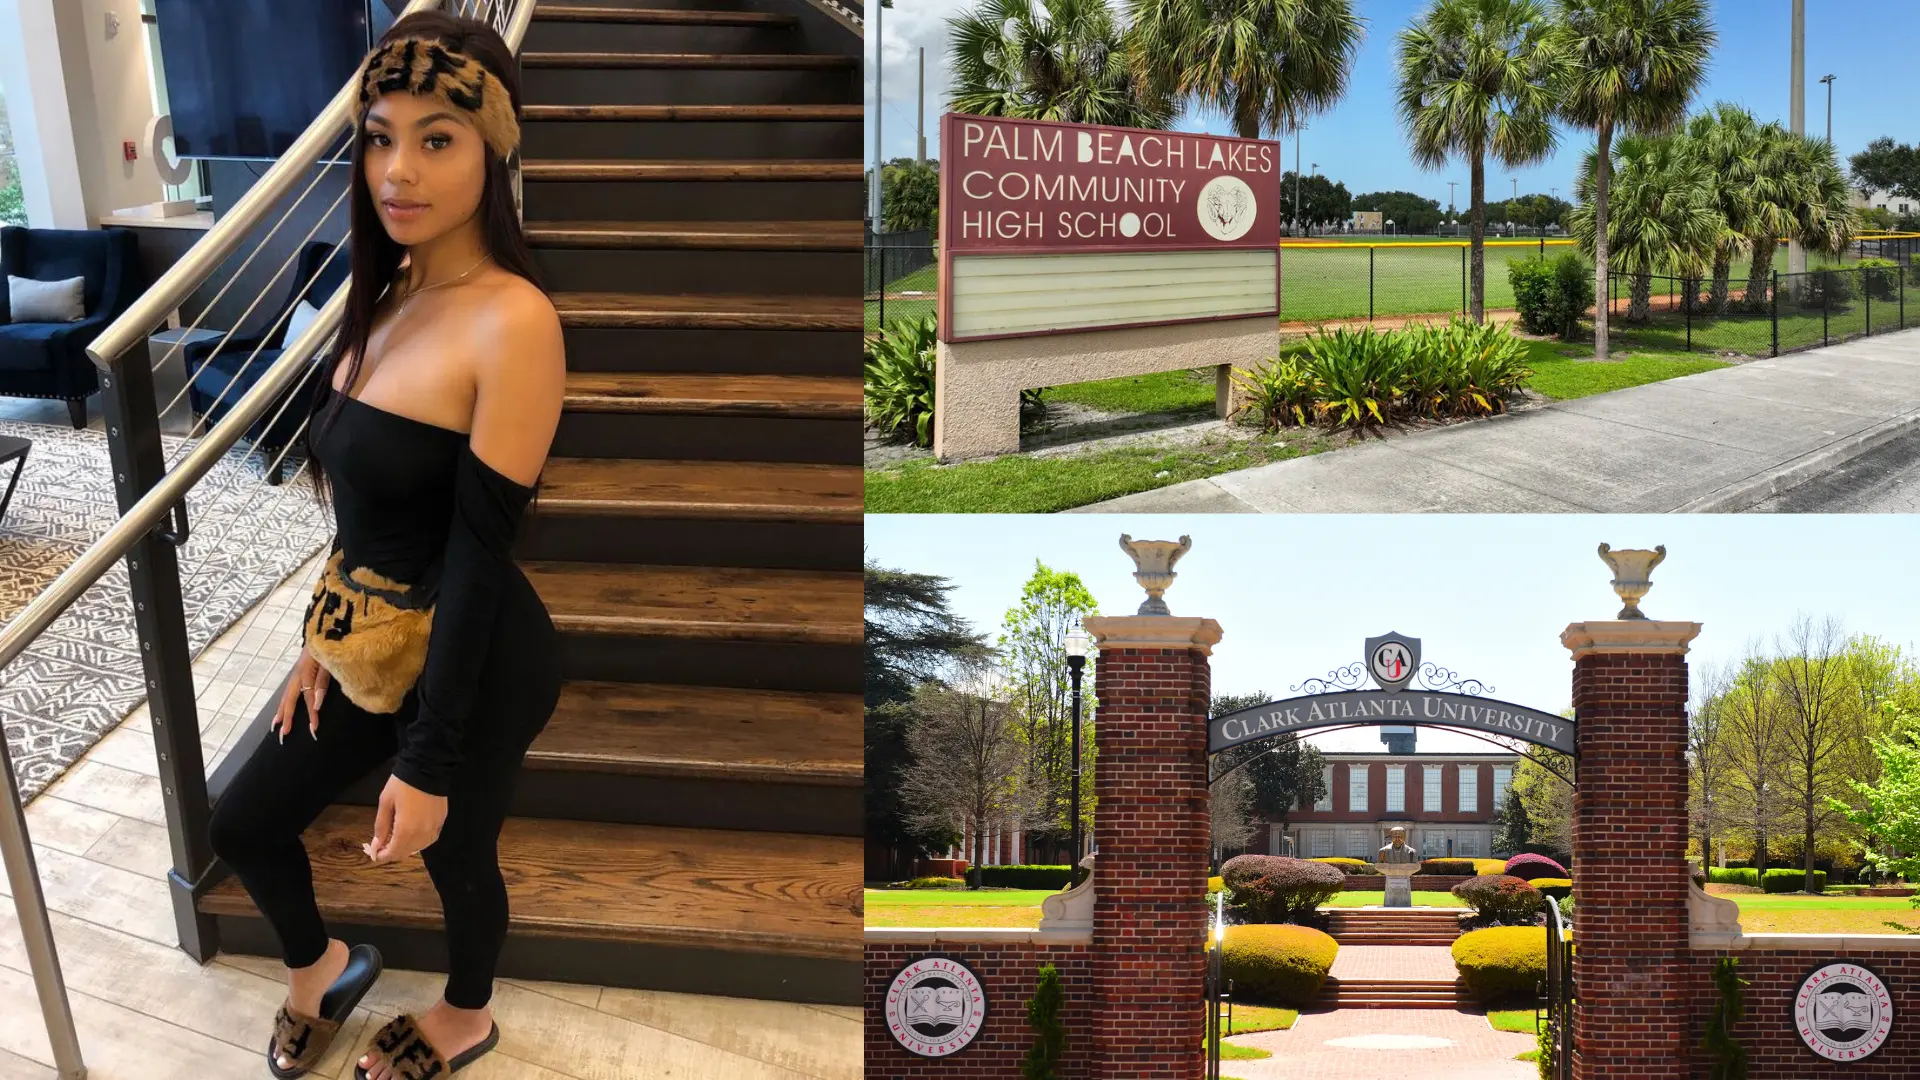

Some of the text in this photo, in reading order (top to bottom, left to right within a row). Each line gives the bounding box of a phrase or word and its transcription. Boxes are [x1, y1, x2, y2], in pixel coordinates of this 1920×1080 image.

[963, 123, 1273, 174] PALM BEACH LAKES
[962, 170, 1186, 204] COMMUNITY
[963, 210, 1176, 239] HIGH SCHOOL
[1221, 696, 1565, 743] CLARK ATLANTA UNIVERSITY
[889, 964, 921, 1003] CLARK
[933, 961, 981, 1003] ATLANTA
[1798, 970, 1828, 1009] CLARK
[1840, 966, 1888, 1008] ATLANTA
[892, 1023, 977, 1054] UNIVERSITY
[1802, 1028, 1886, 1059] UNIVERSITY
